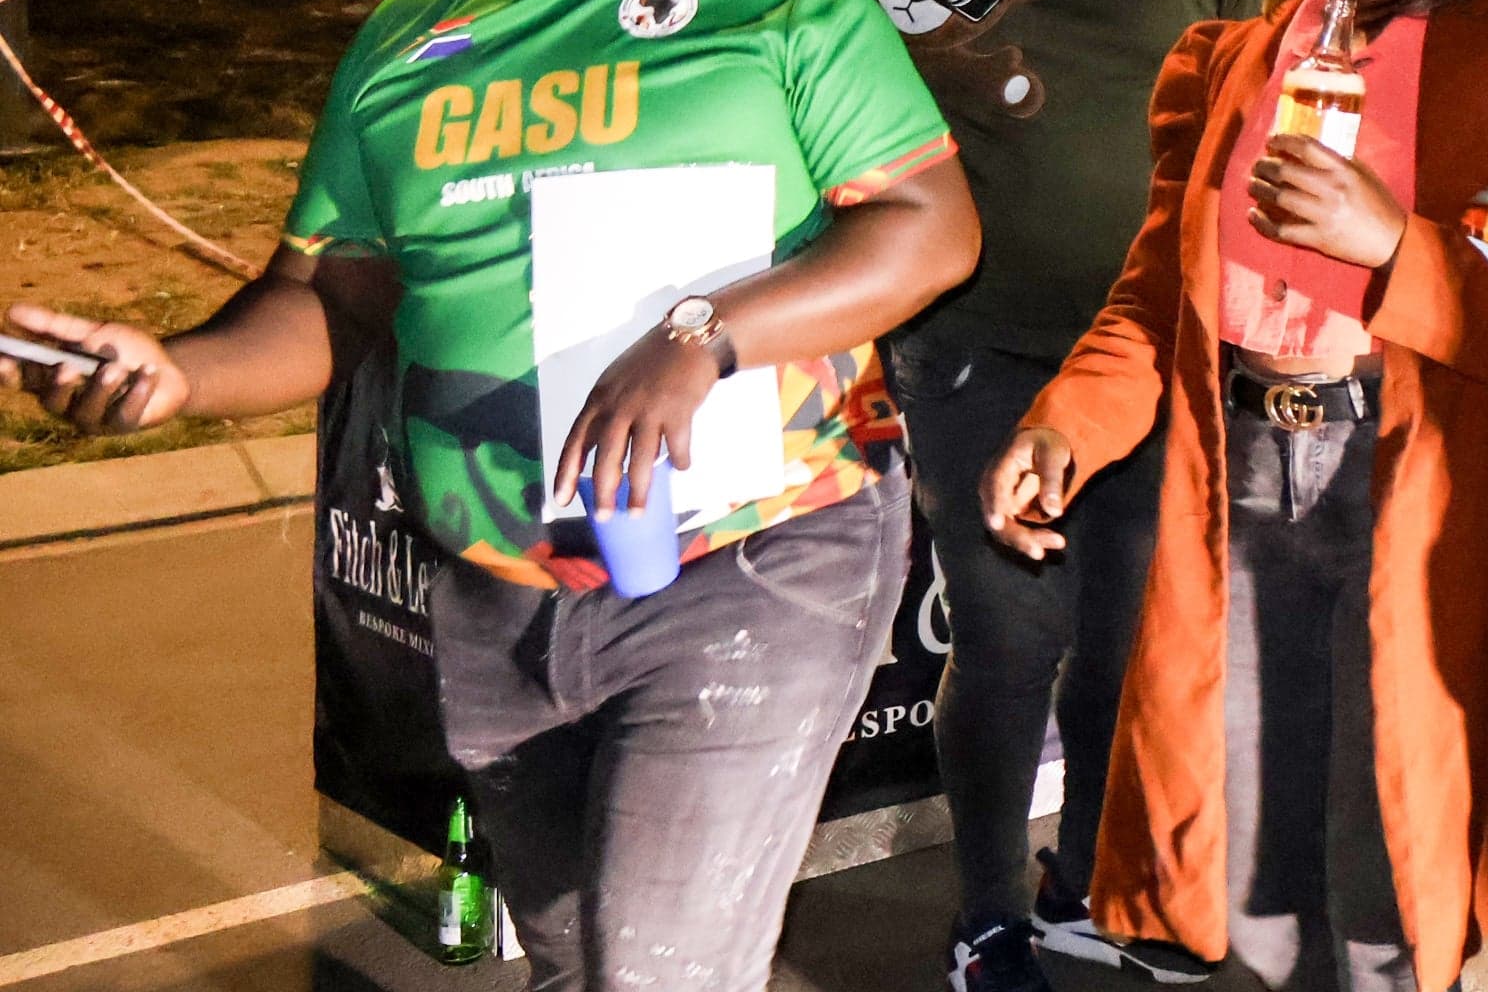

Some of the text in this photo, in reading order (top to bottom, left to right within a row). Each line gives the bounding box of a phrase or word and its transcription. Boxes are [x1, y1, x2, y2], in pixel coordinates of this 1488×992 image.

[414, 60, 640, 170] GASU
[440, 171, 516, 208] SOUTH
[329, 508, 438, 617] Fitch & Le
[359, 609, 407, 645] BESPOKE
[845, 700, 935, 742] SPO
